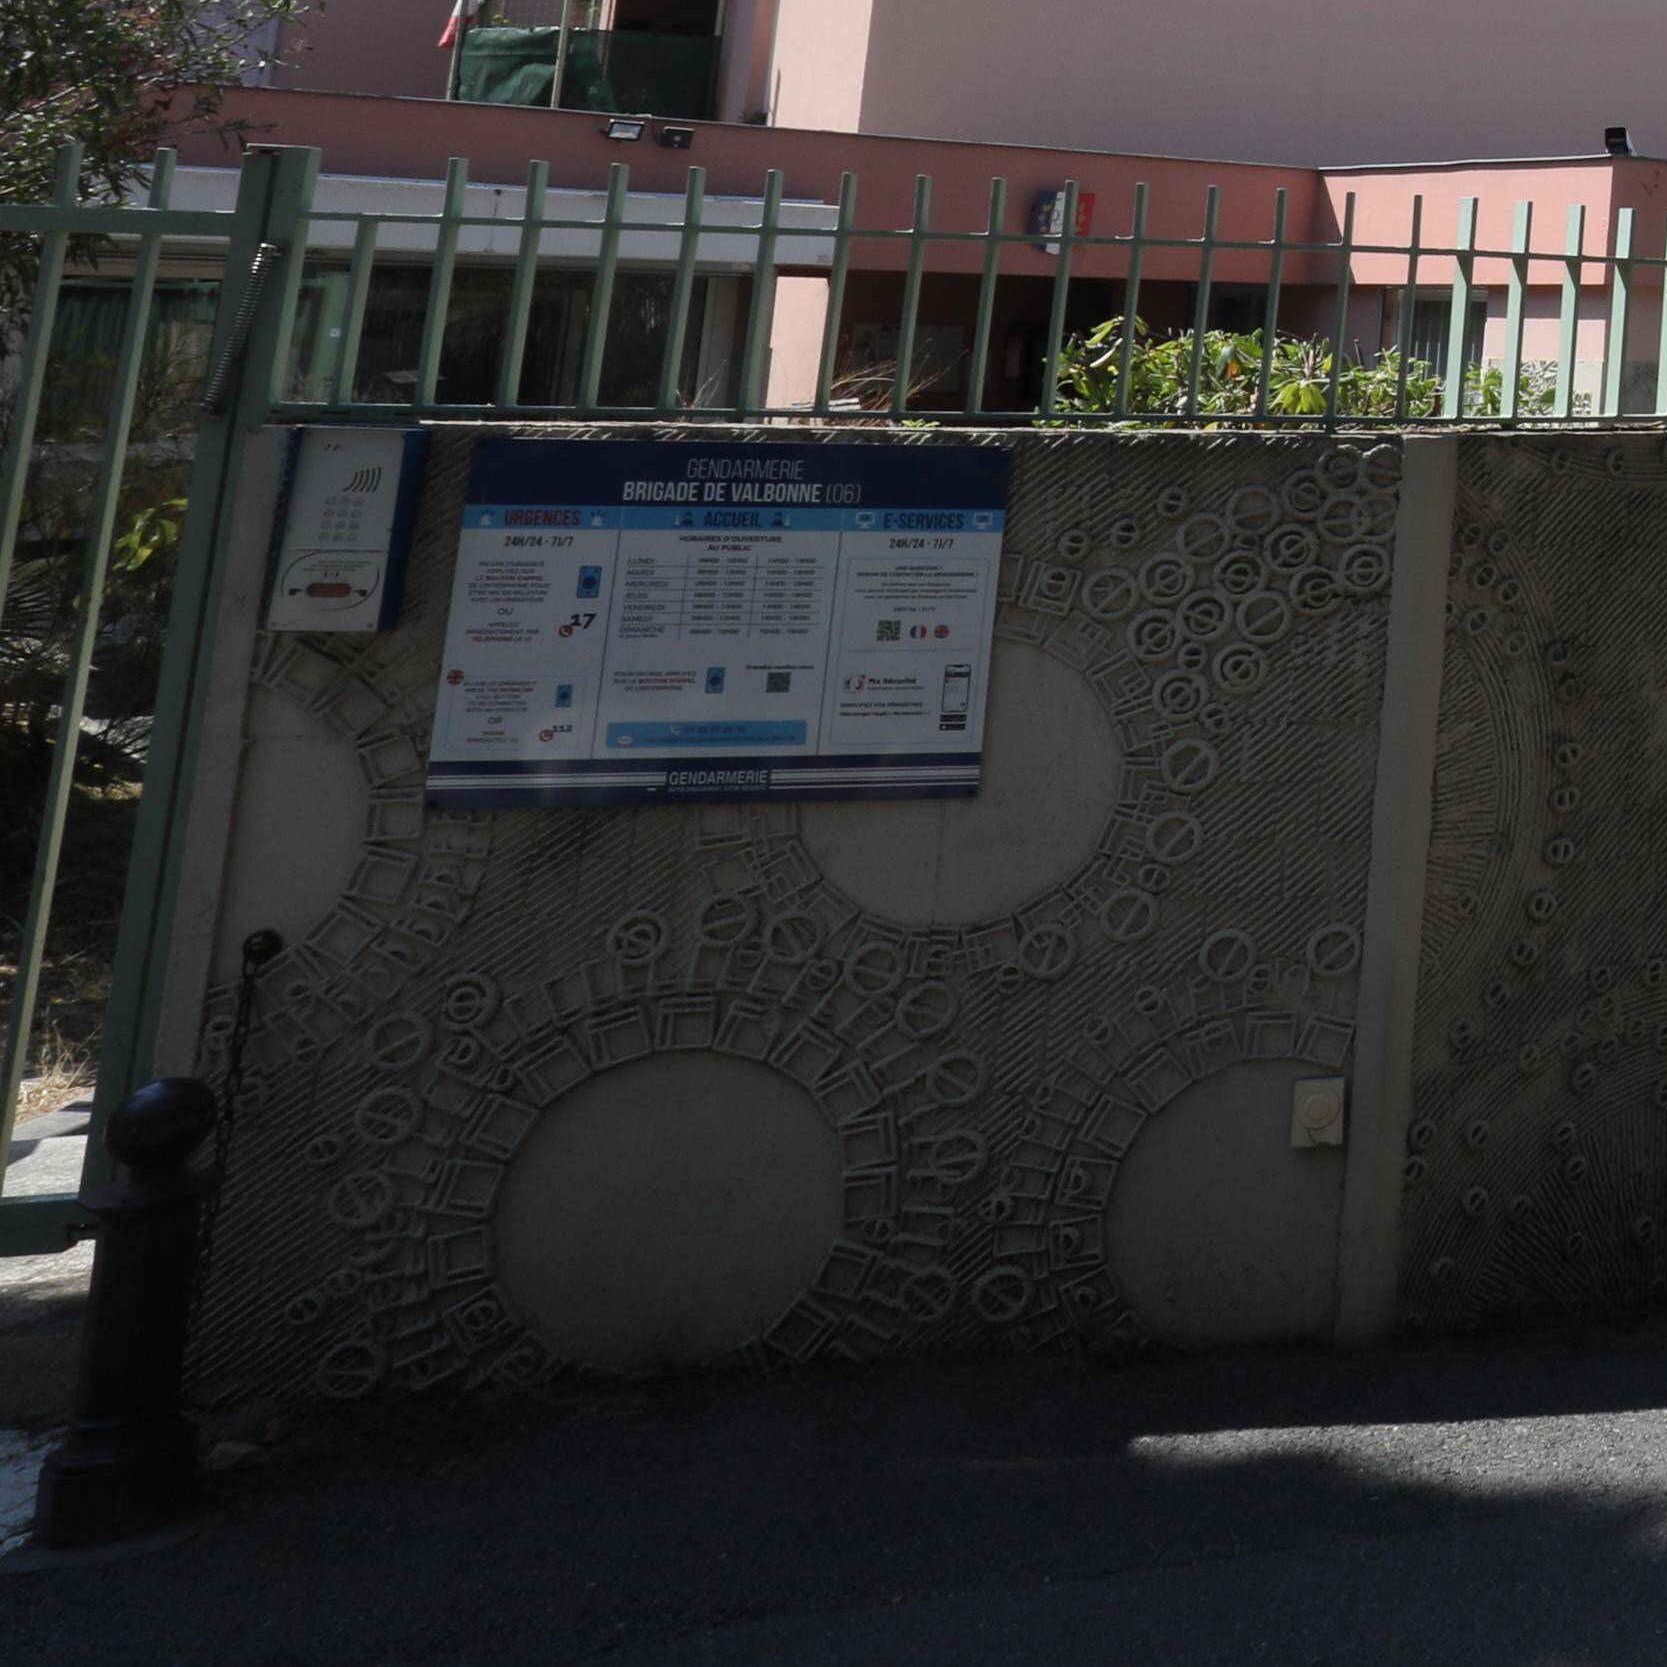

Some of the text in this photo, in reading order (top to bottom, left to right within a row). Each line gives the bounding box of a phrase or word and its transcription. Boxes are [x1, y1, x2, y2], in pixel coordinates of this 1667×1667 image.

[687, 458, 805, 480] GENDARMERIE
[623, 482, 861, 503] BRIGADE DE VALBONNE (06)
[504, 509, 581, 526] URGENCES
[703, 511, 762, 527] ACCUEIL
[884, 513, 965, 530] E-SERVICES
[504, 536, 542, 548] 24H/24
[889, 538, 925, 549] 24H/24
[497, 607, 513, 615] OU
[570, 613, 597, 629] 17
[552, 724, 573, 733] 112
[669, 770, 768, 785] GENDARMERIE
